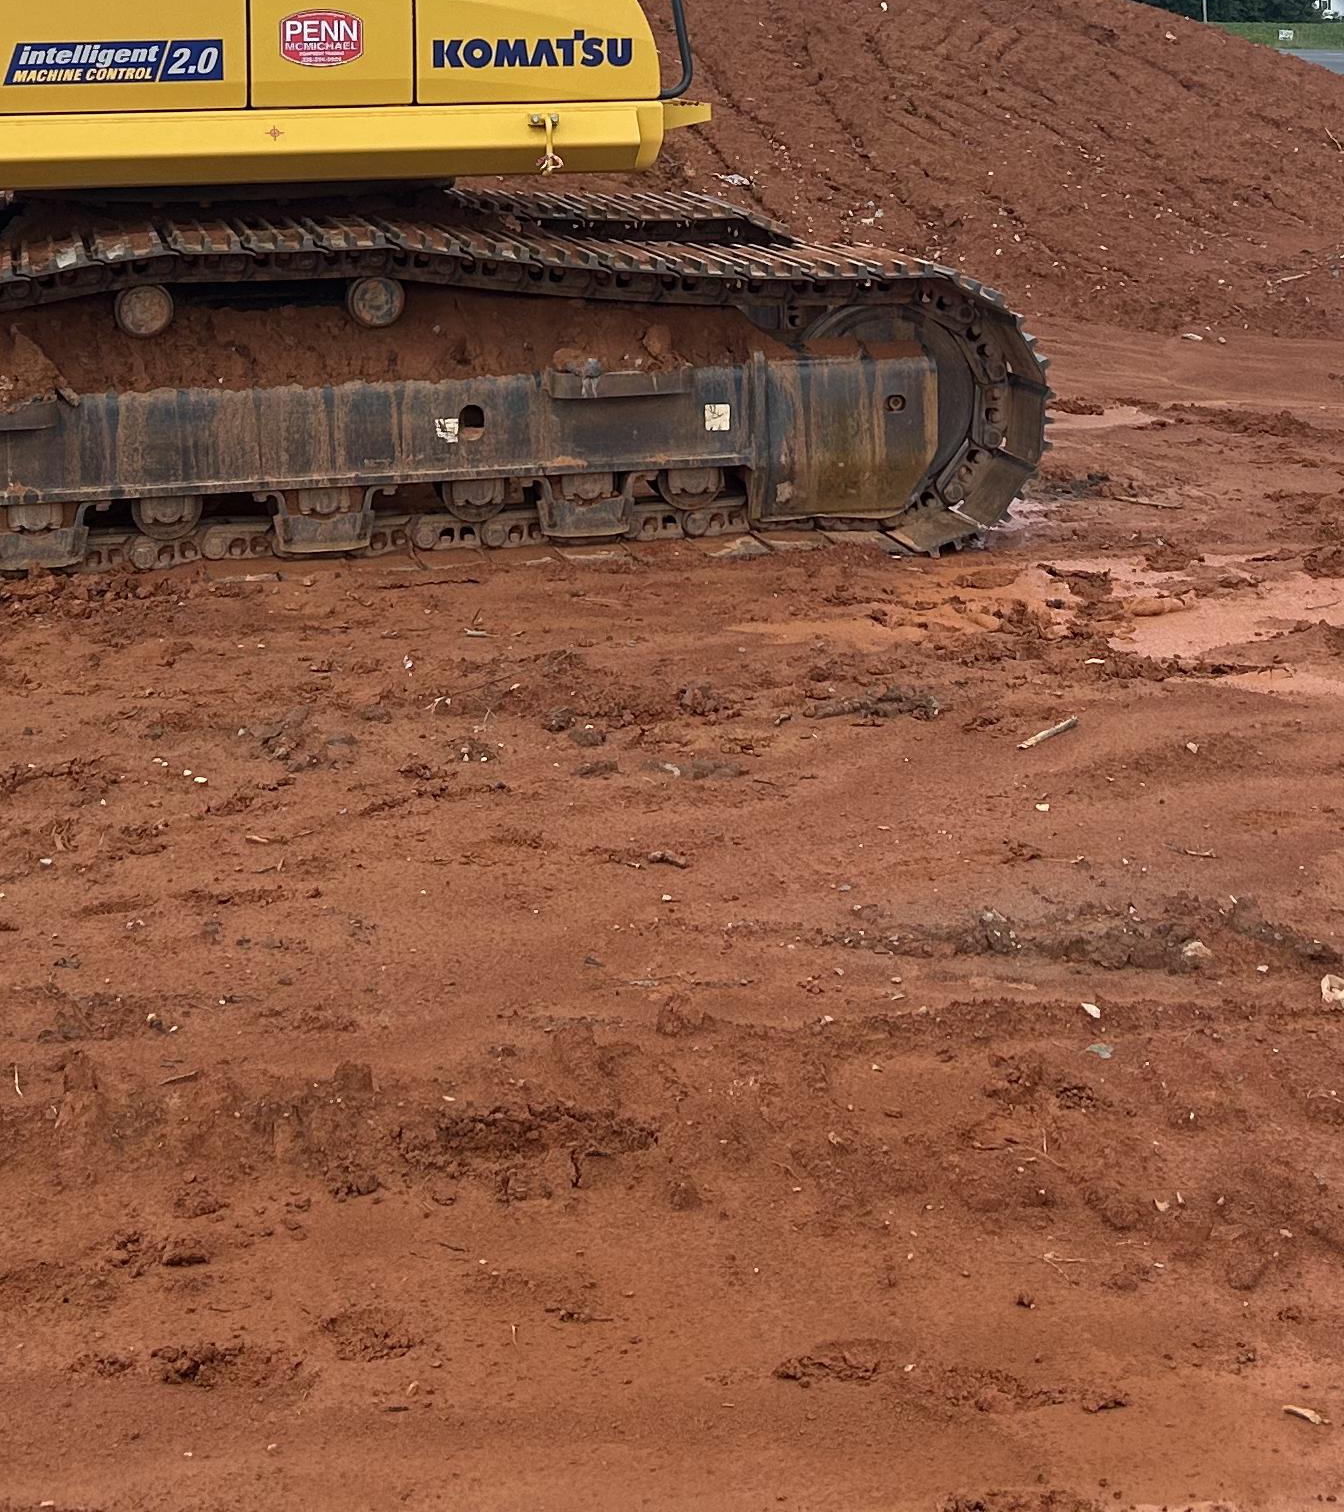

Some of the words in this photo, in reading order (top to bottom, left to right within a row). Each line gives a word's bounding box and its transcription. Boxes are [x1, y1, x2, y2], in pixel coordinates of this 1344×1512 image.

[285, 20, 358, 42] PENN
[18, 44, 160, 68] intelligent
[433, 29, 633, 68] KOMATSU
[167, 47, 219, 75] 2.0
[12, 68, 82, 84] MACHINE
[85, 66, 153, 82] CONTROL
